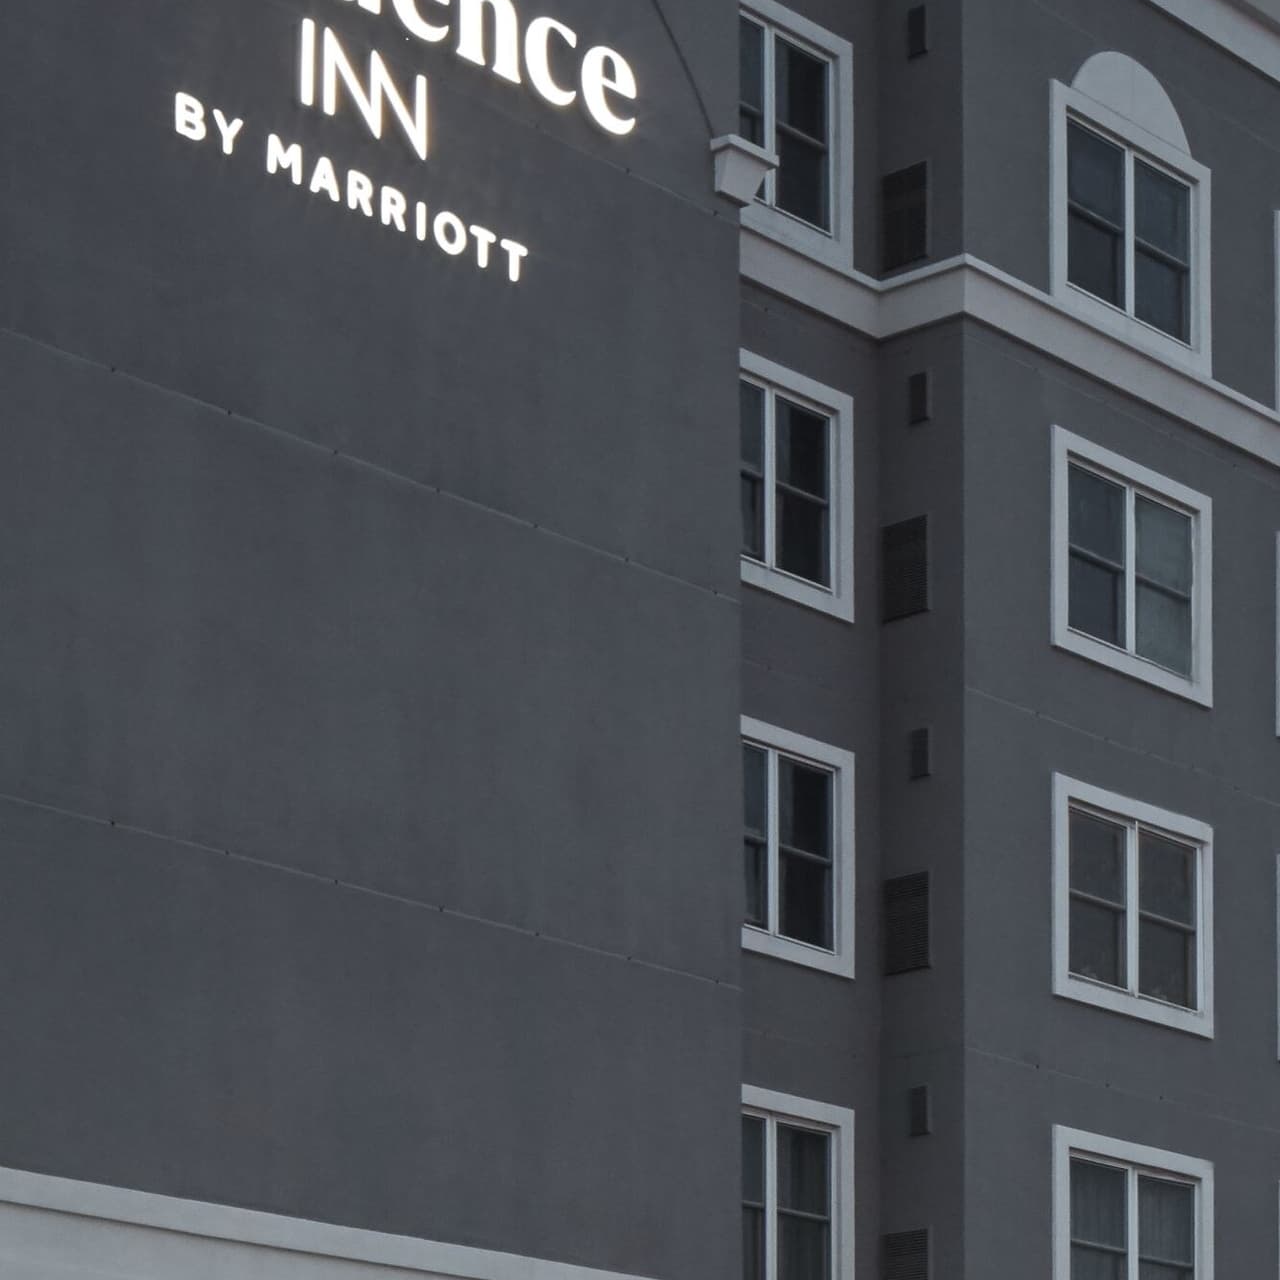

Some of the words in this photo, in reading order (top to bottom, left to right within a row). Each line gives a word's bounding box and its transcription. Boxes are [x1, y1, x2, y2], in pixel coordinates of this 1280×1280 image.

[300, 17, 428, 161] INN
[174, 91, 244, 155] BY
[266, 133, 529, 282] MARRIOTT
